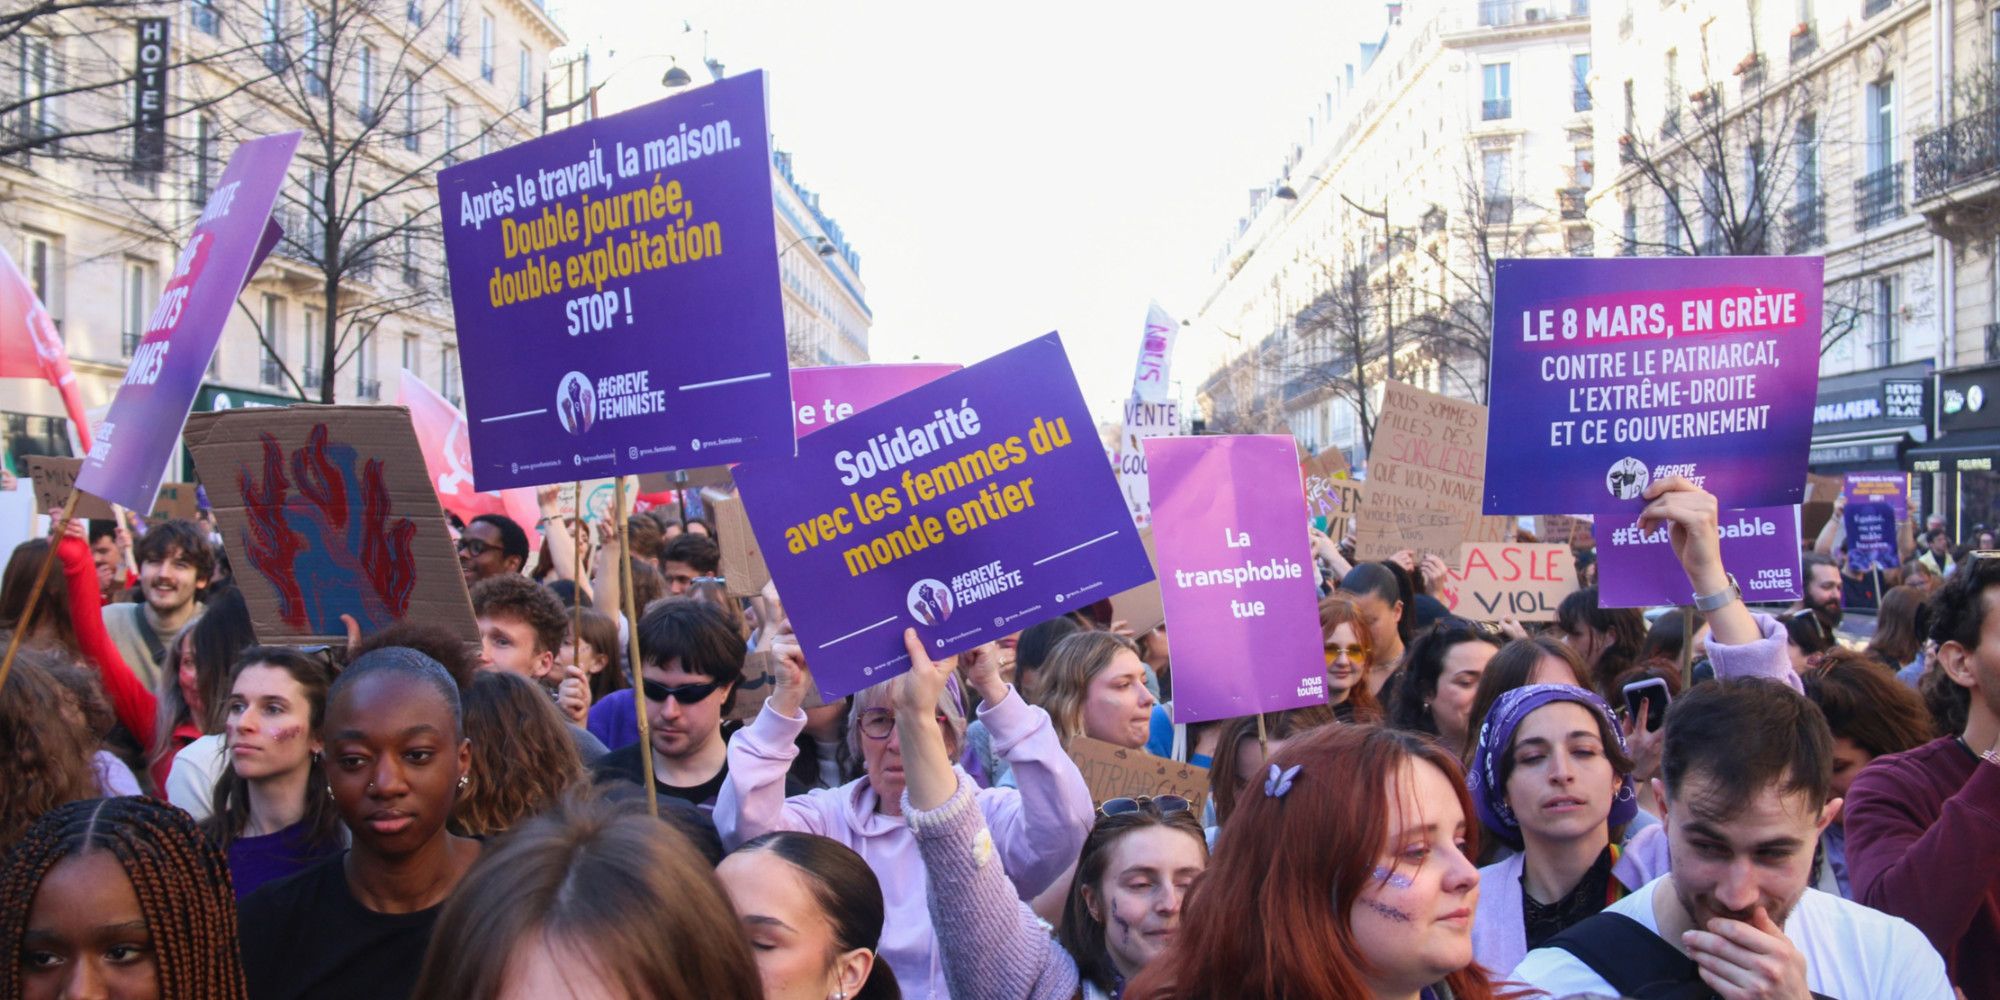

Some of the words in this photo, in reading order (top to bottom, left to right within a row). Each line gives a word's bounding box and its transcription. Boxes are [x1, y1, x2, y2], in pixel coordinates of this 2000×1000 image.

[460, 181, 515, 230] Après
[516, 174, 536, 208] le
[538, 148, 613, 201] travail,
[616, 142, 639, 178] la
[644, 119, 740, 171] maison.
[501, 199, 579, 259] Double
[583, 172, 692, 246] journée,
[490, 251, 562, 308] double
[566, 217, 722, 291] exploitation
[566, 288, 619, 336] STOP
[624, 287, 634, 324] !
[1522, 309, 1554, 342] LE
[1562, 308, 1578, 339] 8
[1586, 303, 1673, 340] MARS,
[1682, 299, 1713, 332] EN
[1720, 288, 1796, 328] GRÈVE
[1541, 352, 1626, 382] CONTRE
[1633, 349, 1656, 377] LE
[1662, 340, 1780, 374] PATRIARCAT,
[598, 370, 649, 399] #GREVE
[1569, 374, 1756, 413] L’EXTRÊME-DROITE
[1885, 384, 1923, 395] RETRO
[1886, 395, 1923, 406] GAME
[599, 390, 666, 420] FEMINISTE
[1124, 404, 1176, 426] VENTE
[1386, 390, 1419, 411] NOUS
[1424, 401, 1478, 428] SOMMES
[1887, 405, 1921, 416] PLAY
[834, 397, 981, 486] Solidarité
[1382, 411, 1433, 438] FILLES
[1443, 426, 1474, 447] DES
[1551, 421, 1575, 447] ET
[1581, 419, 1608, 444] CE
[1614, 405, 1771, 443] GOUVERNEMENT
[785, 507, 853, 555] avec
[851, 486, 902, 526] les
[901, 436, 1027, 507] femmes
[1028, 416, 1072, 456] du
[1374, 463, 1398, 484] QUE
[1405, 469, 1436, 492] VOUS
[1440, 479, 1482, 502] N'AVE
[843, 515, 945, 577] monde
[946, 478, 1035, 536] entier
[1225, 527, 1251, 548] La
[952, 560, 1004, 592] #GREVE
[956, 570, 1023, 607] FEMINISTE
[1175, 558, 1302, 589] transphobie
[1749, 577, 1793, 590] toutes
[1758, 567, 1791, 579] nous
[1231, 600, 1265, 618] tue
[1474, 591, 1556, 614] VIOL
[1297, 684, 1323, 697] toutes
[1302, 676, 1322, 686] nous
